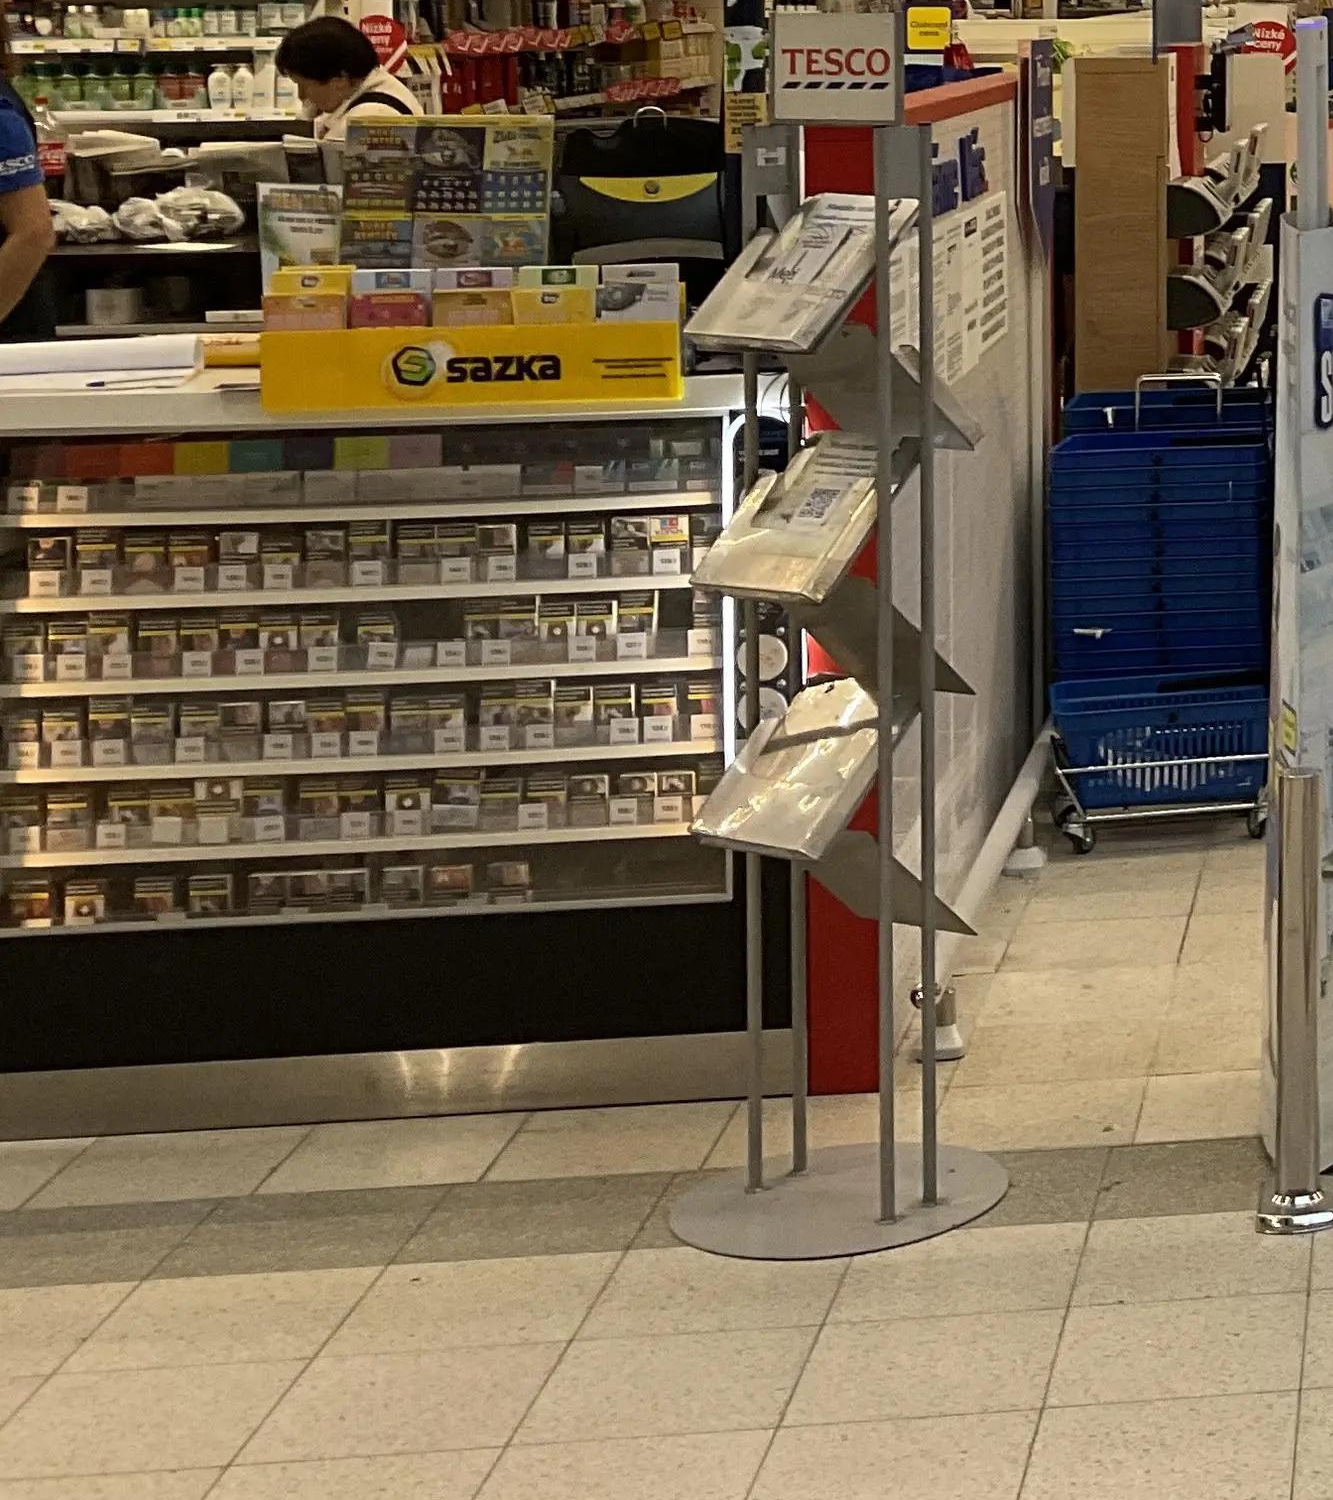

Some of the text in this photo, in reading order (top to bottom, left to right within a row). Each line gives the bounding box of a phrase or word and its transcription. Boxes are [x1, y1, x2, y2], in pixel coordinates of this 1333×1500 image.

[1252, 27, 1286, 41] Nízké
[781, 48, 890, 77] TESCO
[446, 354, 561, 383] sazka
